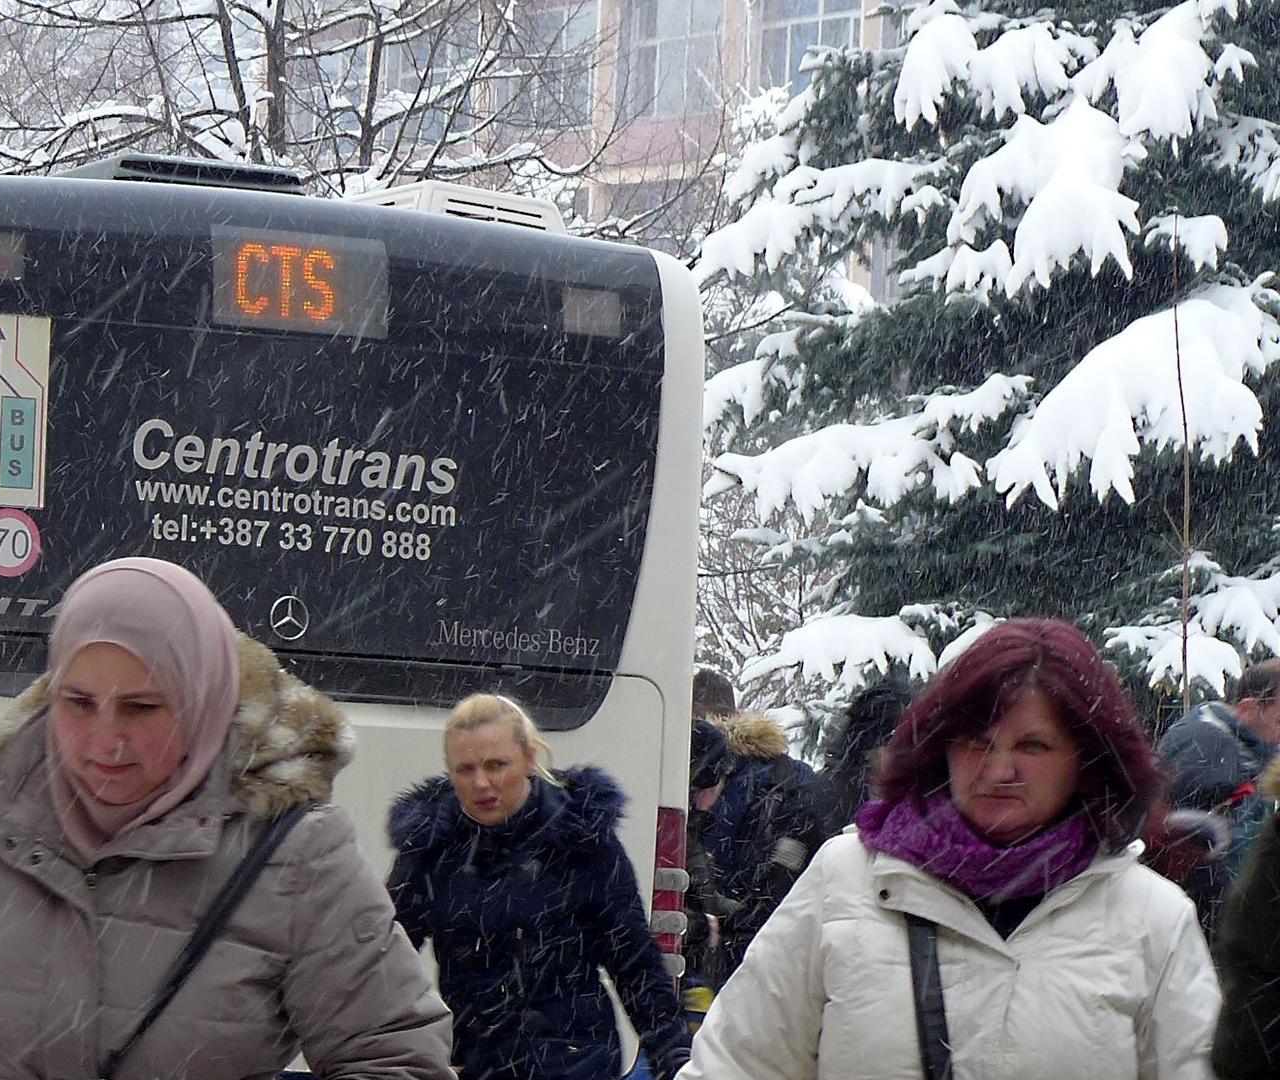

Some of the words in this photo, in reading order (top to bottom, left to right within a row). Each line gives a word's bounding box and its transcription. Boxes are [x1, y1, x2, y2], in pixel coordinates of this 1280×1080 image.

[236, 241, 335, 321] CTS
[7, 408, 25, 477] BUS
[133, 418, 458, 494] Centrotrans
[135, 480, 456, 526] www.centrotrans.com
[151, 512, 270, 547] tel:+387
[279, 522, 313, 551] 33
[322, 526, 372, 556] 770
[381, 531, 431, 561] 888
[438, 619, 600, 657] Mercedes-Benz
